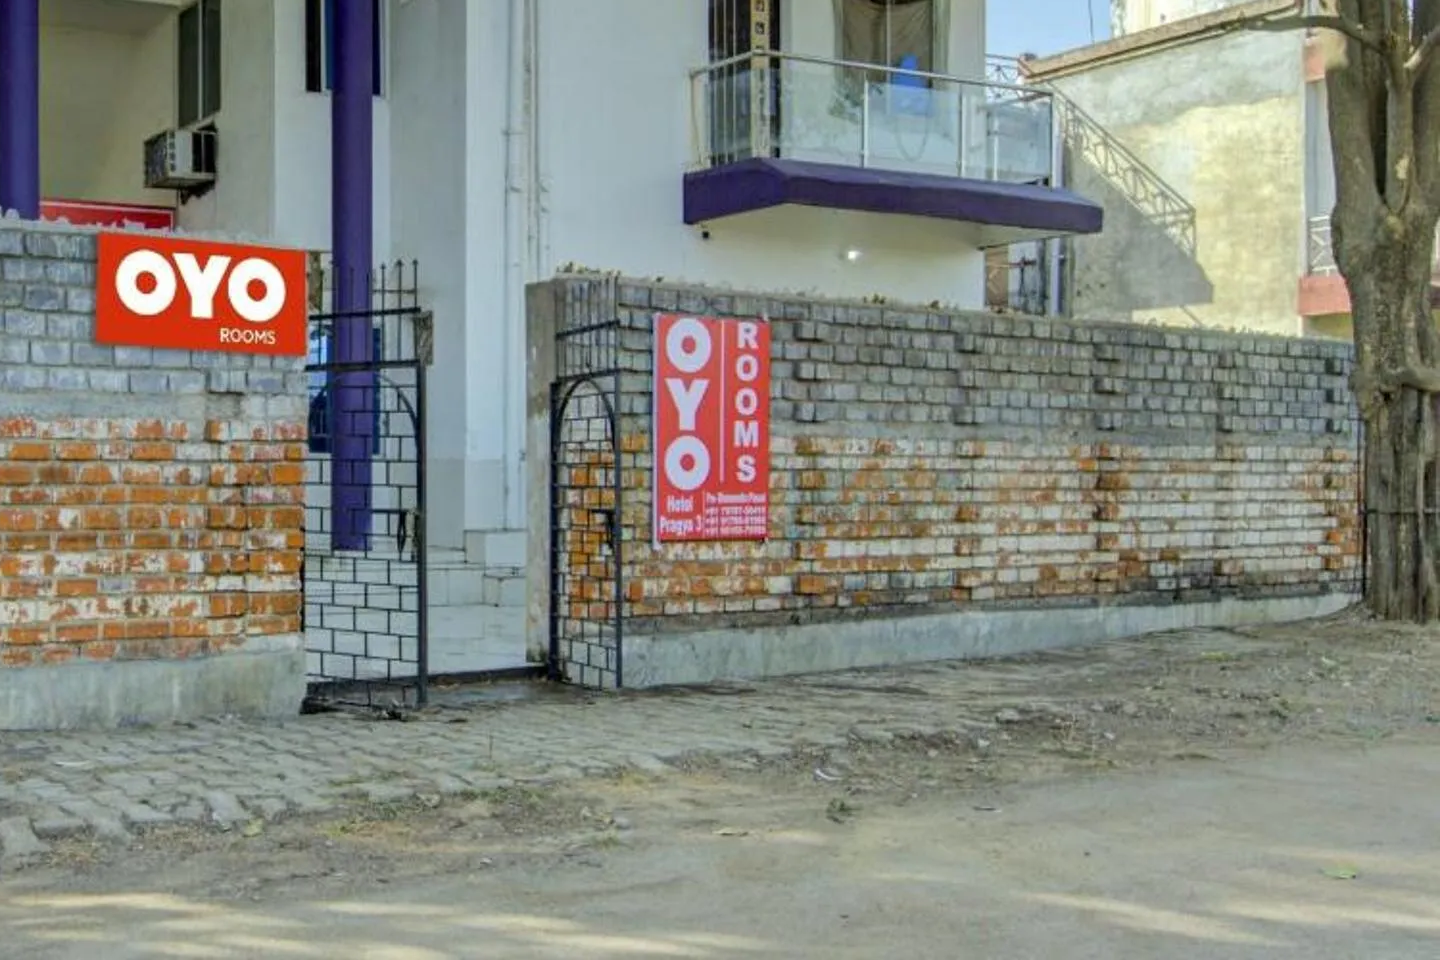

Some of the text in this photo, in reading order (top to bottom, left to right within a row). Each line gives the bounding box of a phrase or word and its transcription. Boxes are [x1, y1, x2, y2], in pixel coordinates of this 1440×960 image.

[115, 249, 287, 322] OYO
[219, 328, 276, 345] ROOMS
[664, 317, 711, 490] OYO
[734, 322, 760, 483] ROOMS
